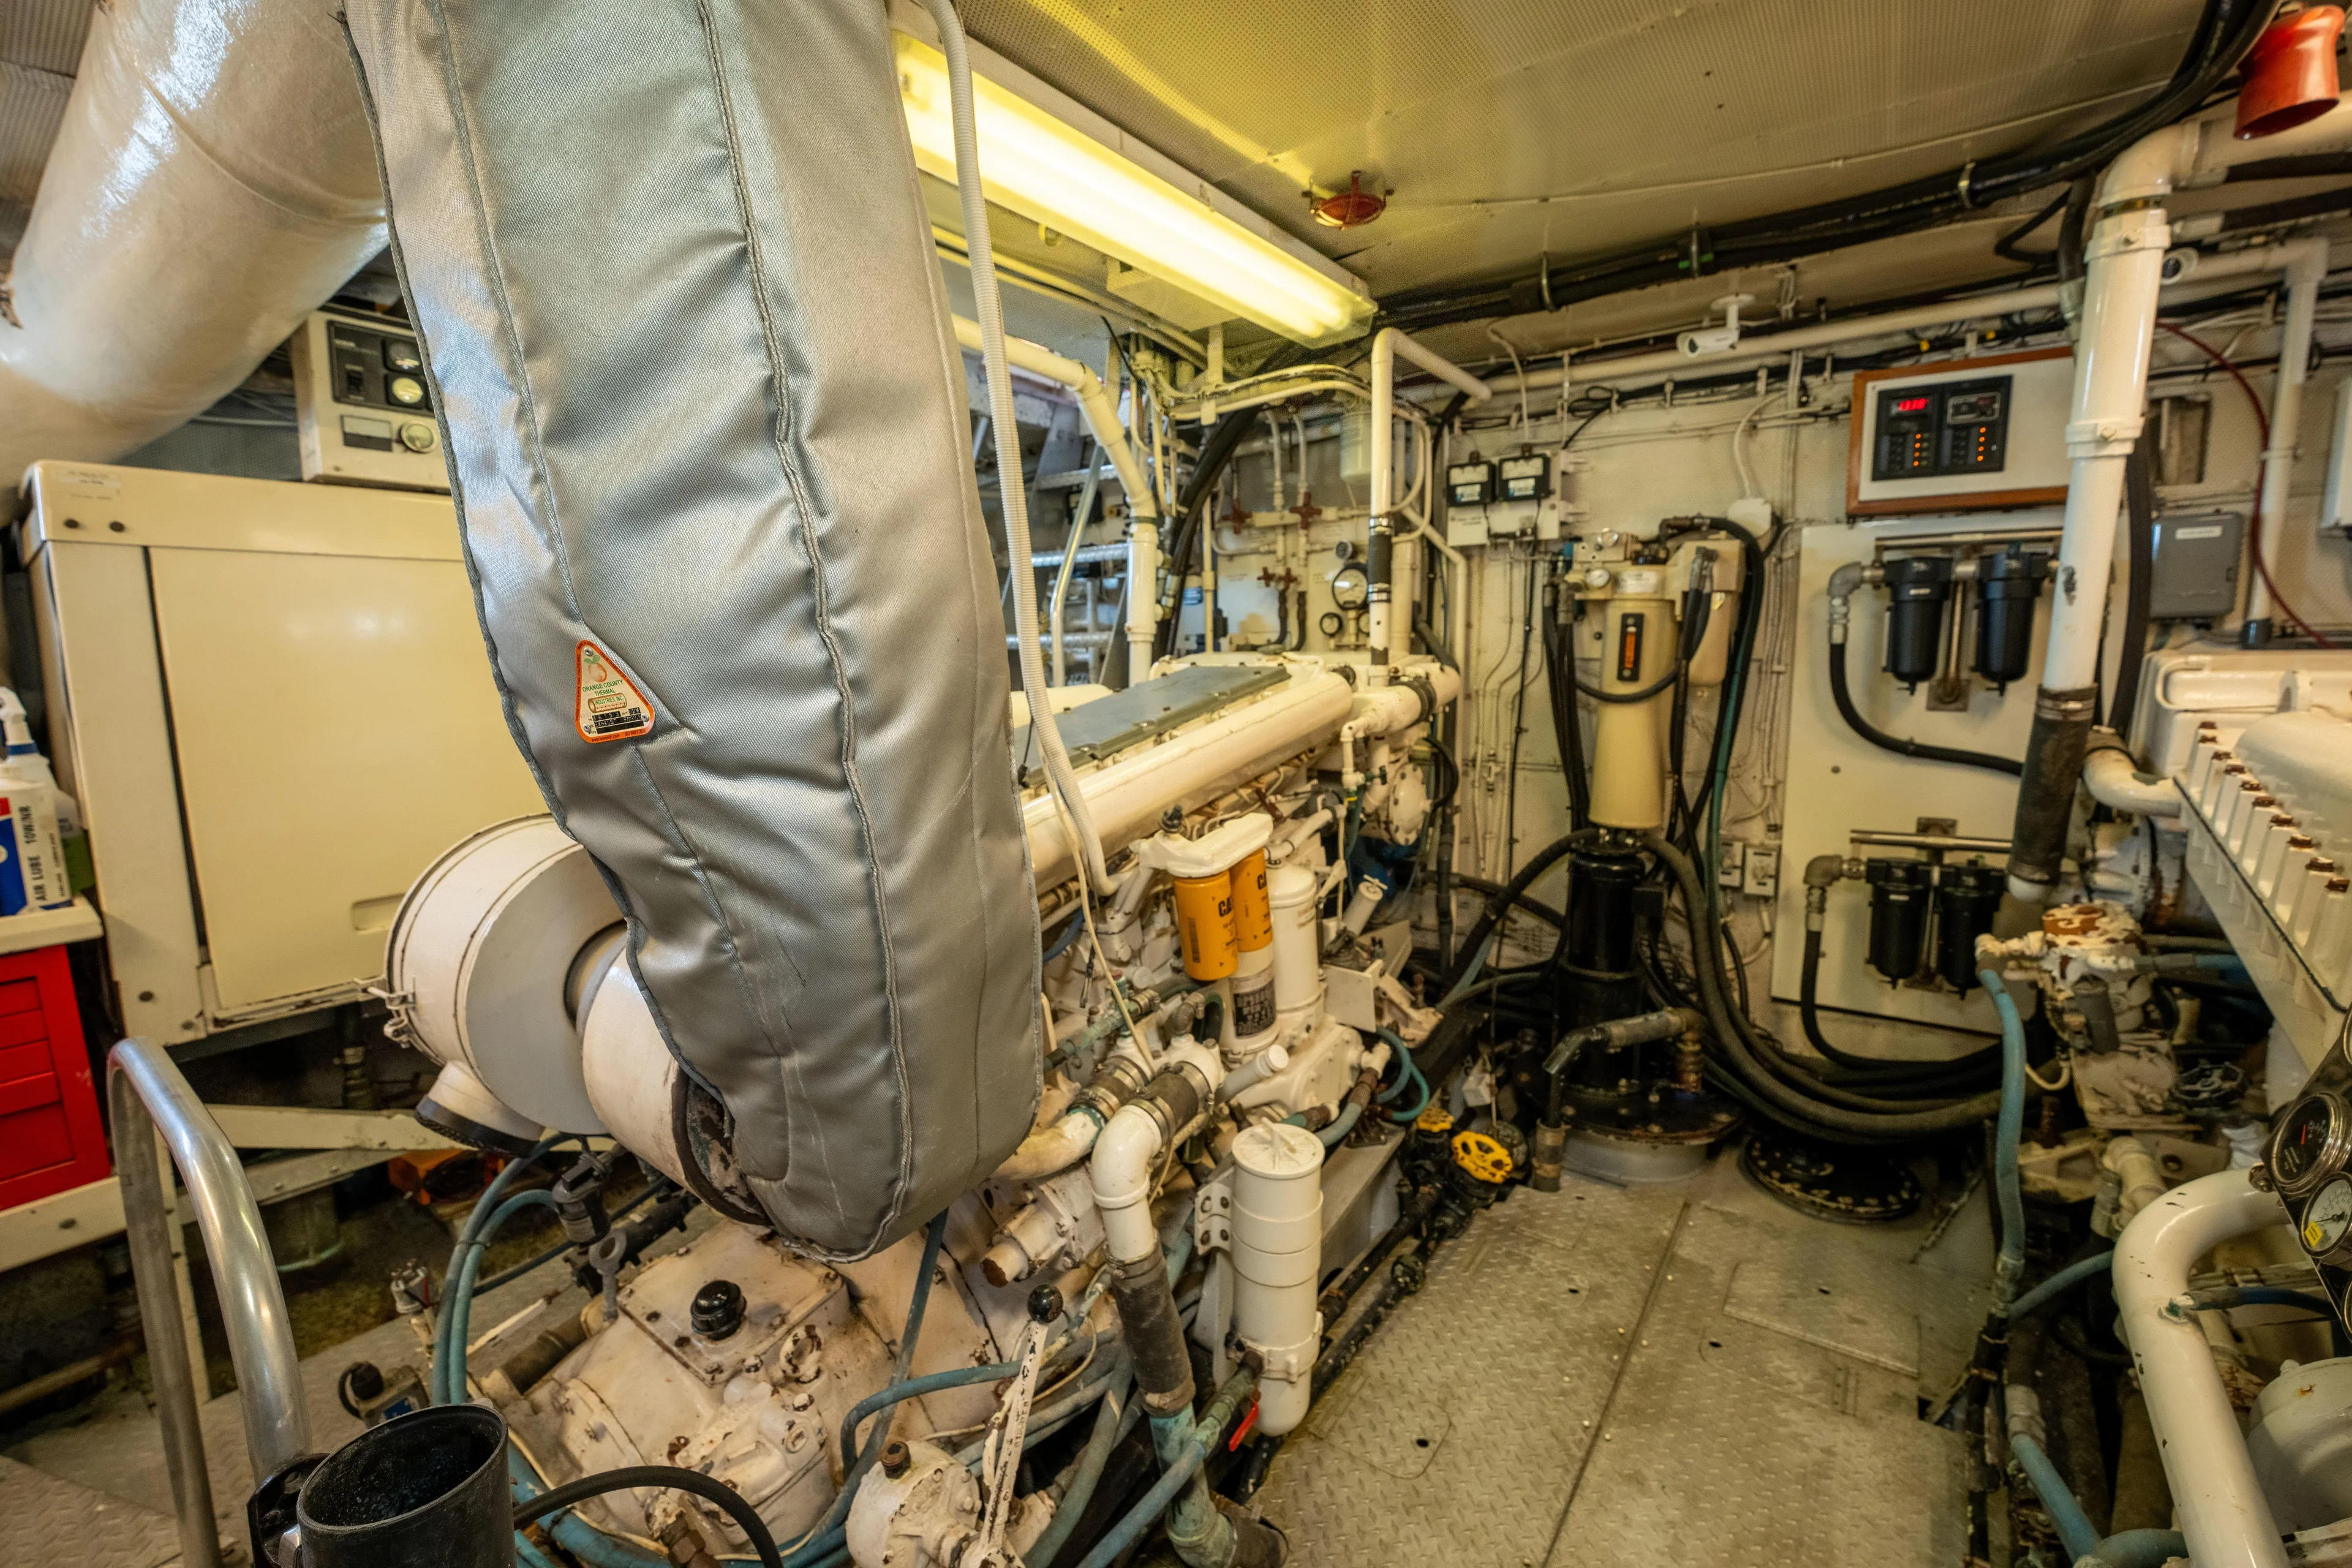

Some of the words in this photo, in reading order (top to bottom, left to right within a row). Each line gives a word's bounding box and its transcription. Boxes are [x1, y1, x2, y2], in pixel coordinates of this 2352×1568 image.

[582, 684, 603, 692] ORANGE
[595, 696, 617, 705] INDUSTRIES,
[28, 855, 45, 881] LUBE
[33, 883, 47, 902] AIR
